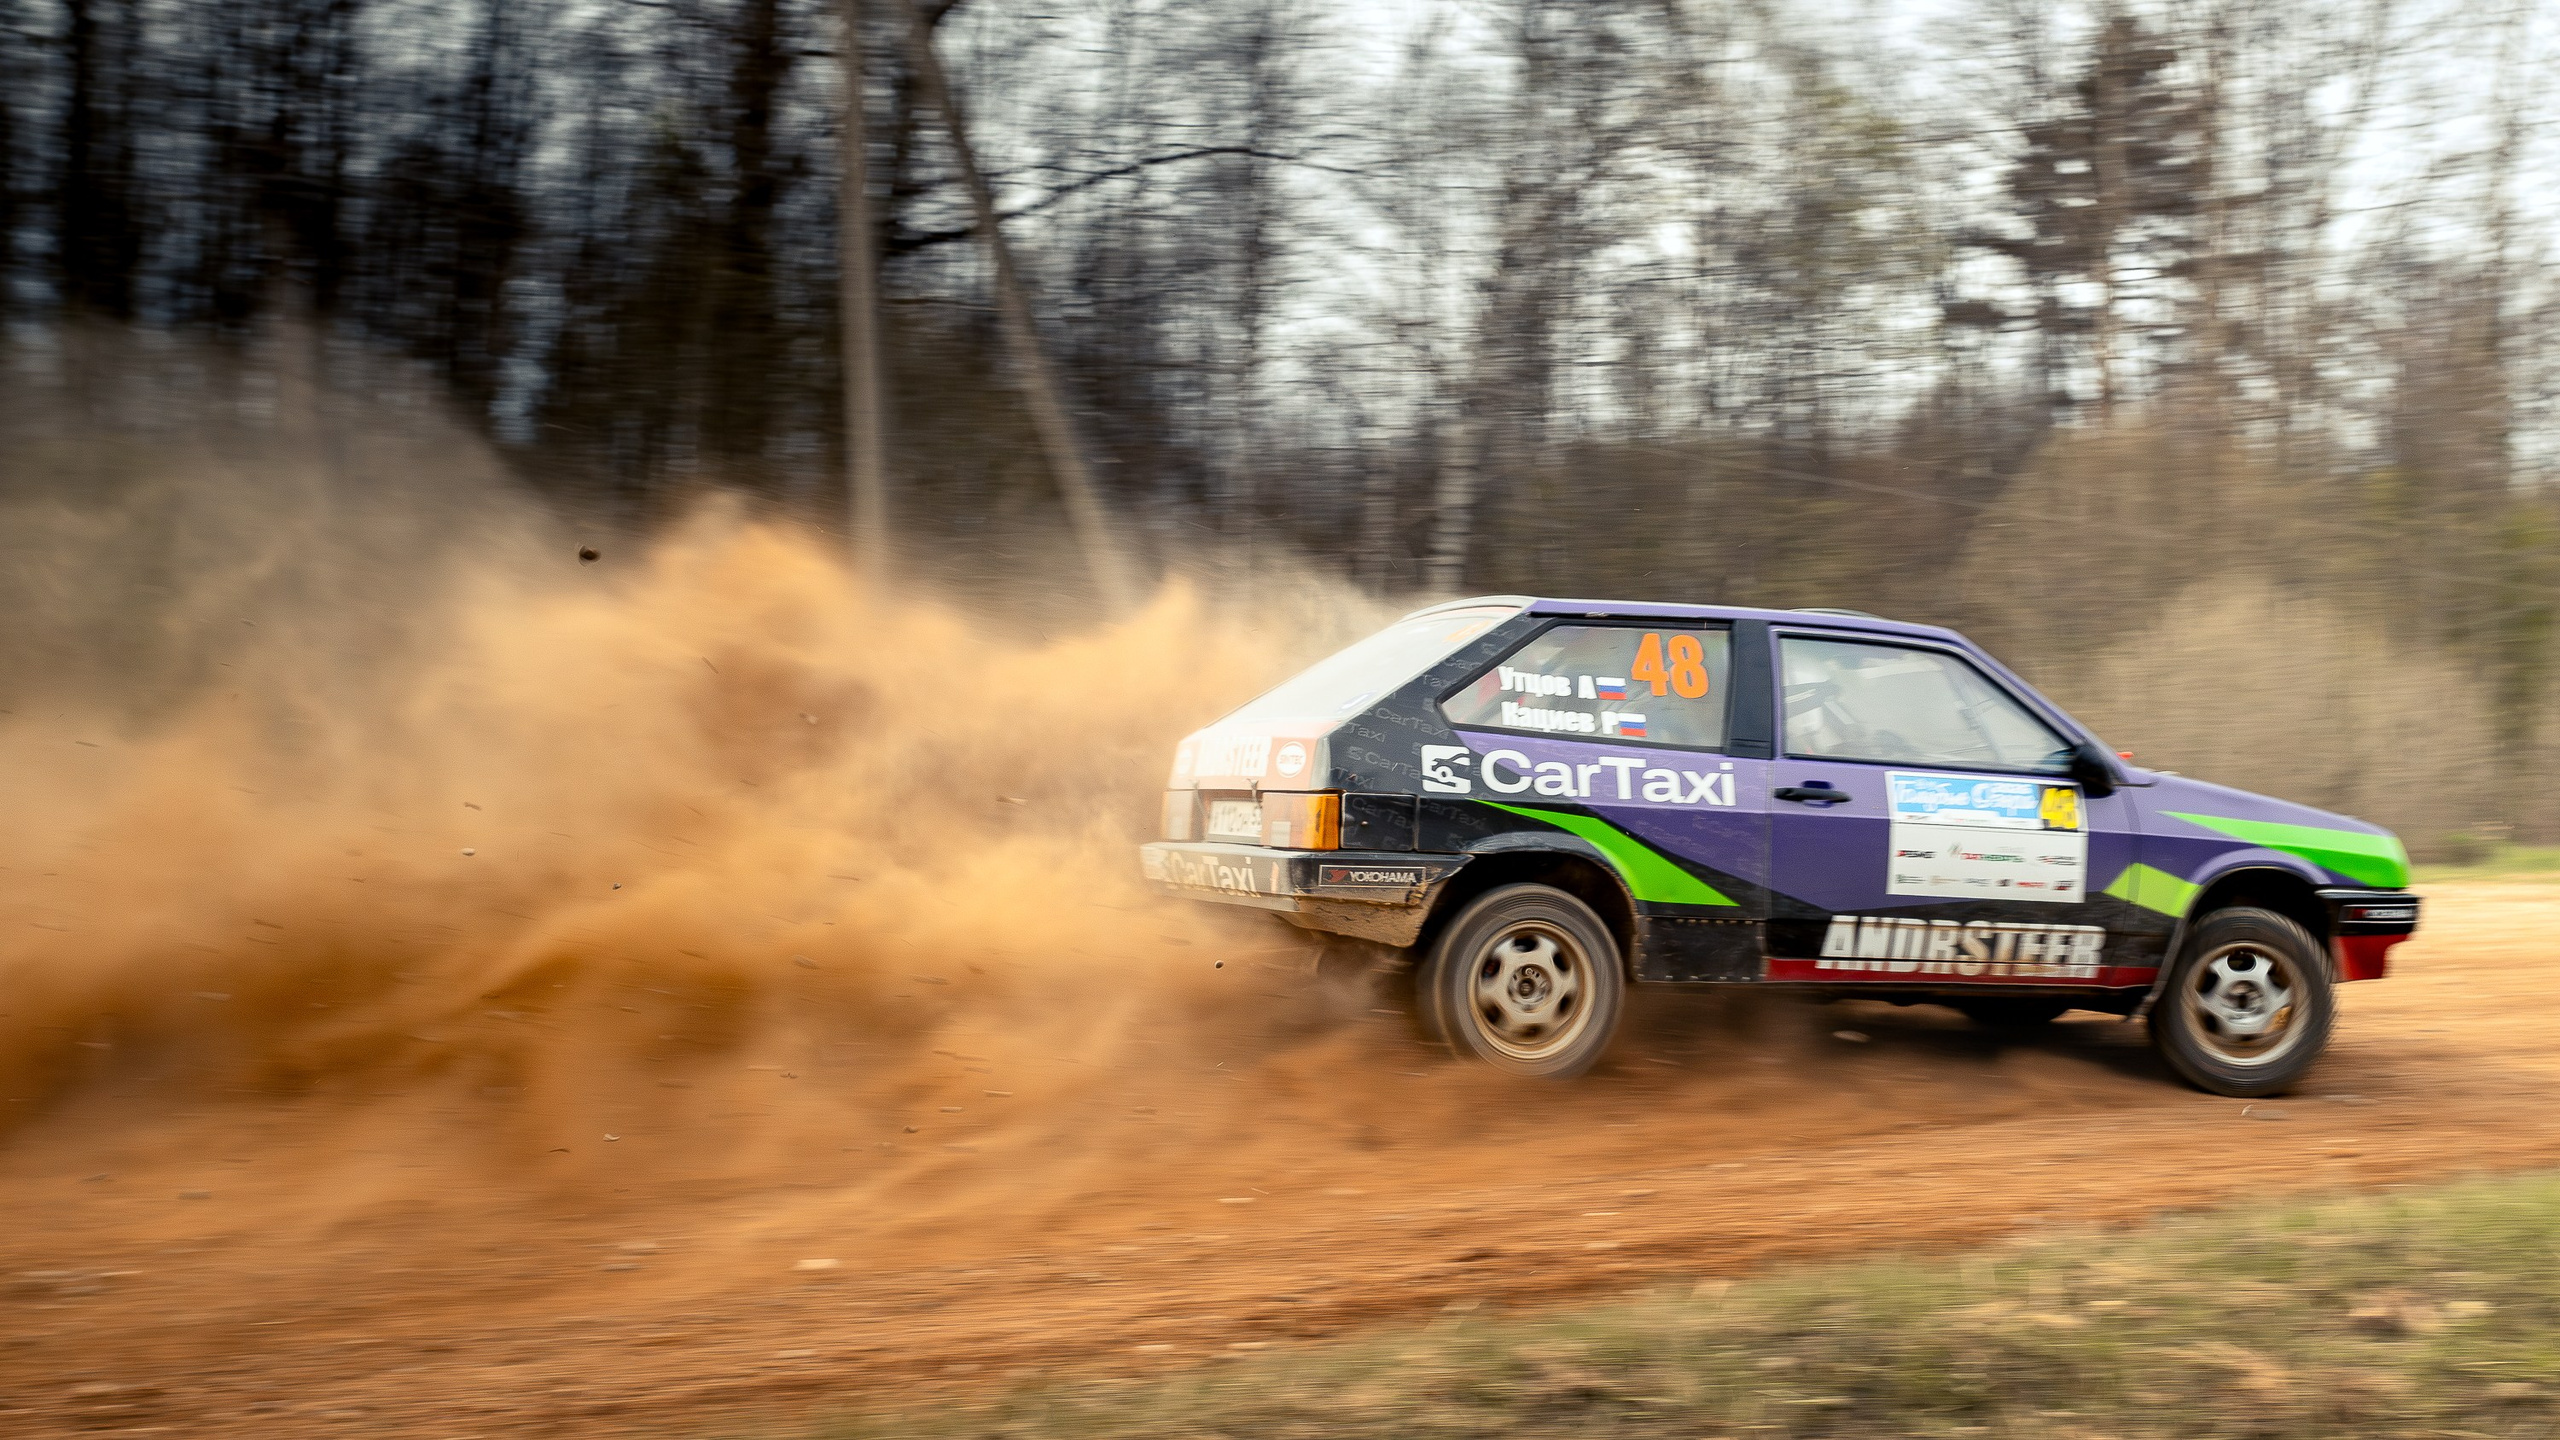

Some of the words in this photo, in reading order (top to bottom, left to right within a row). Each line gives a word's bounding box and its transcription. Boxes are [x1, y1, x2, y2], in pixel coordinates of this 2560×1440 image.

[1498, 666, 1572, 698] Утцов
[1631, 633, 1709, 699] 48
[1480, 749, 1736, 806] CarTaxi
[1167, 851, 1262, 897] CarTaxi
[1349, 870, 1417, 884] YOKOHAMA
[1815, 915, 2106, 978] ANDRSTEER
